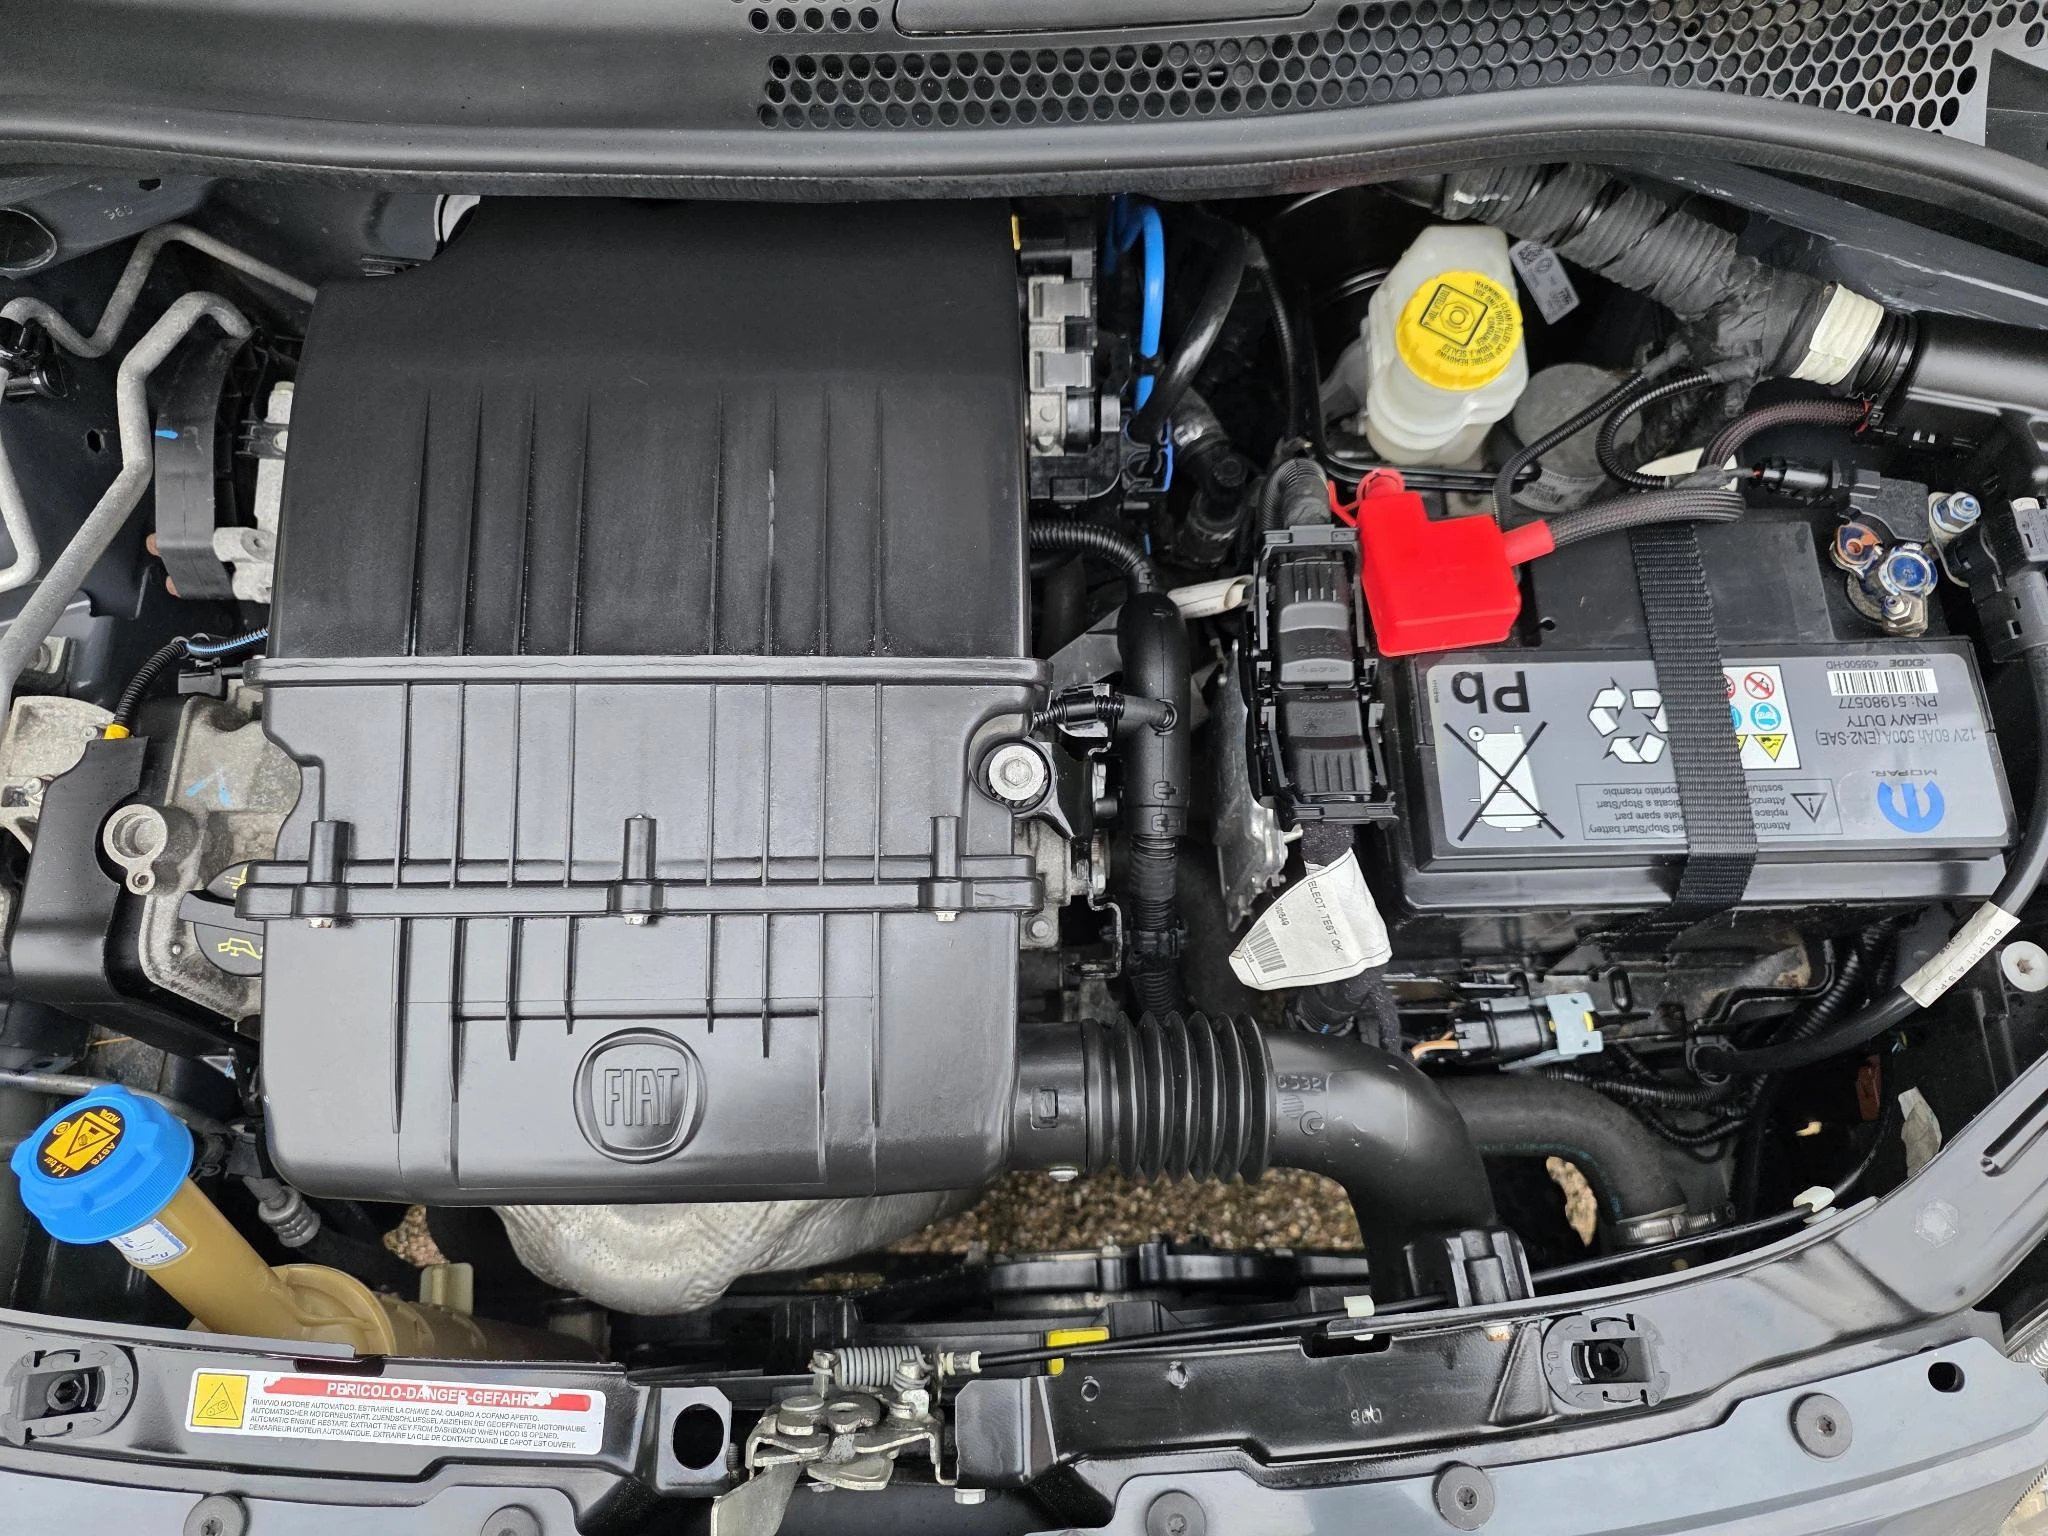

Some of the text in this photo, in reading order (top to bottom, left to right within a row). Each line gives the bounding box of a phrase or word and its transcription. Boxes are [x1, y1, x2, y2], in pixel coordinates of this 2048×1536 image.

[1450, 671, 1530, 715] Pb
[1838, 695, 1938, 709] PN: 51980577
[1846, 713, 1938, 728] HEAVY DUTY
[1602, 787, 1643, 796] ricambio
[1596, 799, 1643, 809] Stop/Start
[1615, 811, 1634, 821] part
[1635, 811, 1662, 820] spare
[1754, 809, 1789, 818] replace
[1588, 823, 1621, 834] battery
[1626, 823, 1670, 834] Stop/Start
[1321, 913, 1337, 936] TEST
[1331, 938, 1344, 954] OK
[1966, 928, 2003, 965] DELPHI
[604, 1068, 680, 1126] FIAT
[43, 1156, 58, 1168] bar
[250, 1406, 308, 1417] AUTOMATISCHER
[252, 1398, 279, 1406] RIAVVIO
[280, 1400, 309, 1408] MOTORE
[310, 1401, 356, 1411] AUTOMATICO.
[444, 1409, 474, 1418] QUADRO
[481, 1411, 509, 1420] COFANO
[510, 1413, 539, 1422] APERTO.
[249, 1415, 289, 1424] AUTOMATIC
[290, 1417, 316, 1426] ENGINE
[350, 1421, 381, 1429] EXTRACT
[412, 1424, 432, 1432] FROM
[434, 1426, 476, 1435] DASHBOARD
[477, 1428, 498, 1436] WHEN
[499, 1429, 519, 1437] HOOD
[292, 1426, 321, 1434] MOTEUR
[441, 1434, 474, 1443] CONTACT
[509, 1438, 532, 1447] CAPOT
